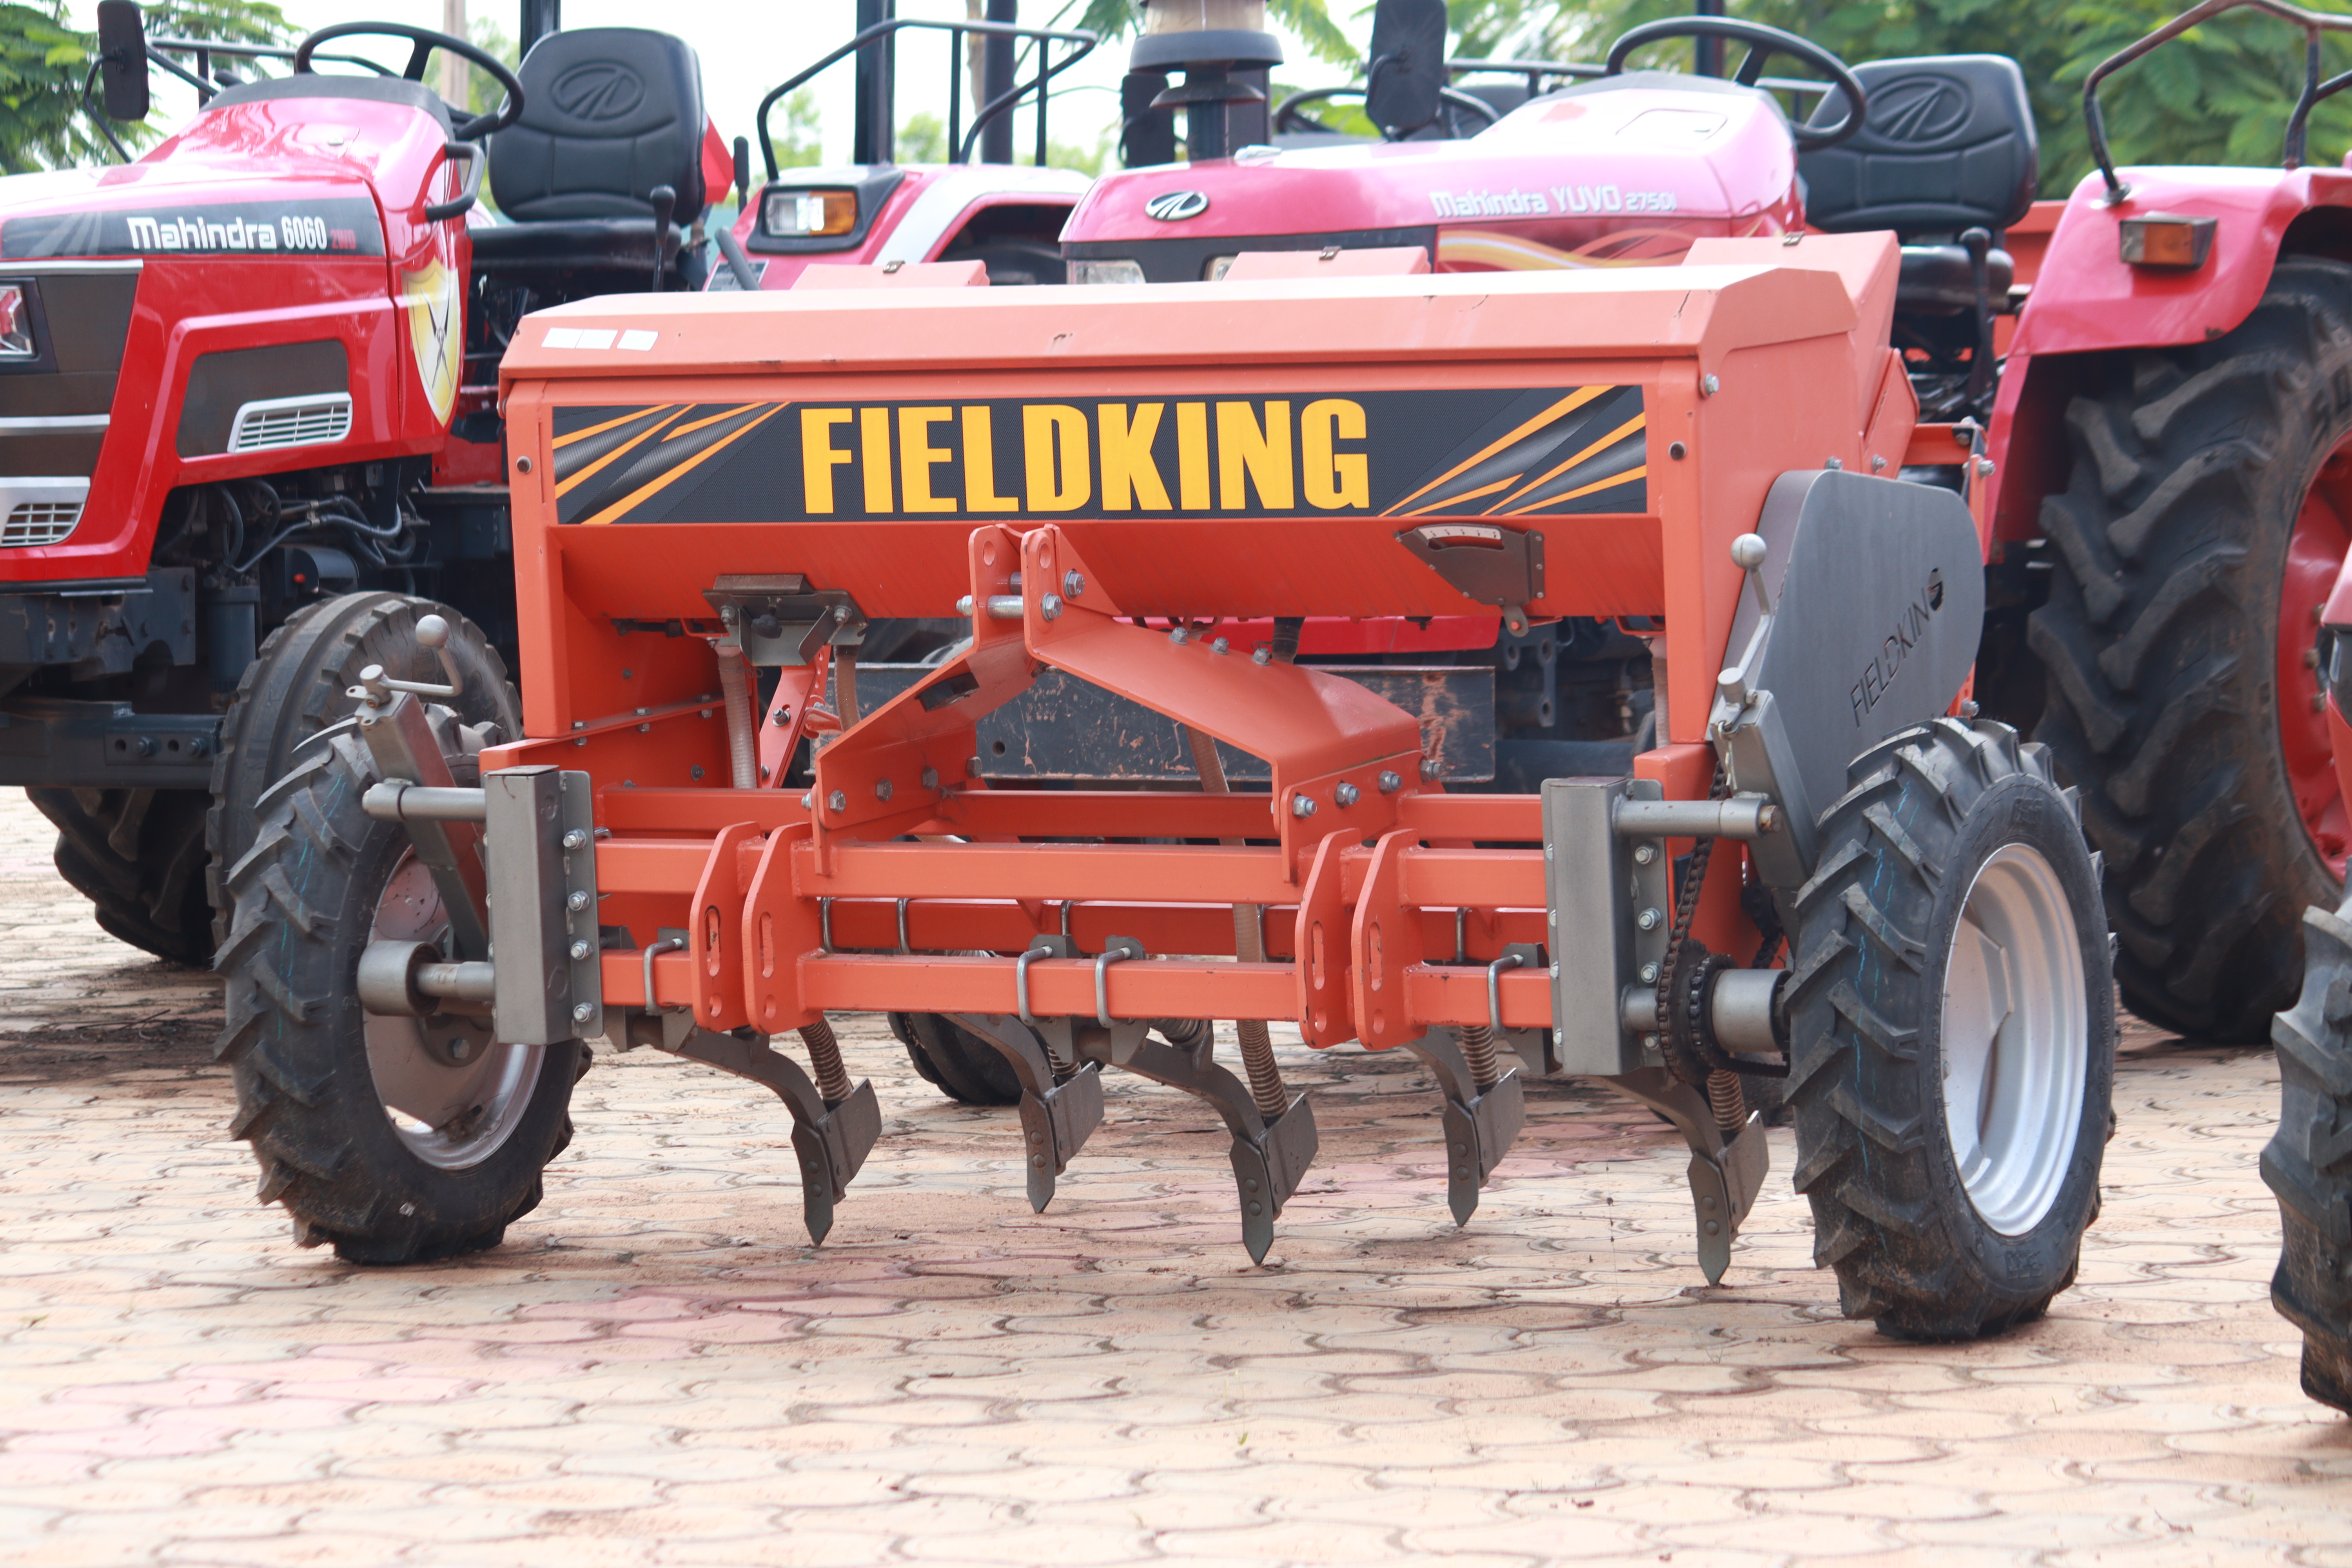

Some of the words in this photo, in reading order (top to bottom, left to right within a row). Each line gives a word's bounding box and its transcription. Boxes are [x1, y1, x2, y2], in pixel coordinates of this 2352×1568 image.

[127, 216, 277, 250] Mahindra
[281, 216, 327, 250] 6060
[330, 229, 357, 250] 2WD
[1428, 187, 1550, 218] Mahindra
[1549, 185, 1622, 212] YUVO
[800, 398, 1370, 514] FIELDKING
[1850, 567, 1944, 730] FIELDKING
